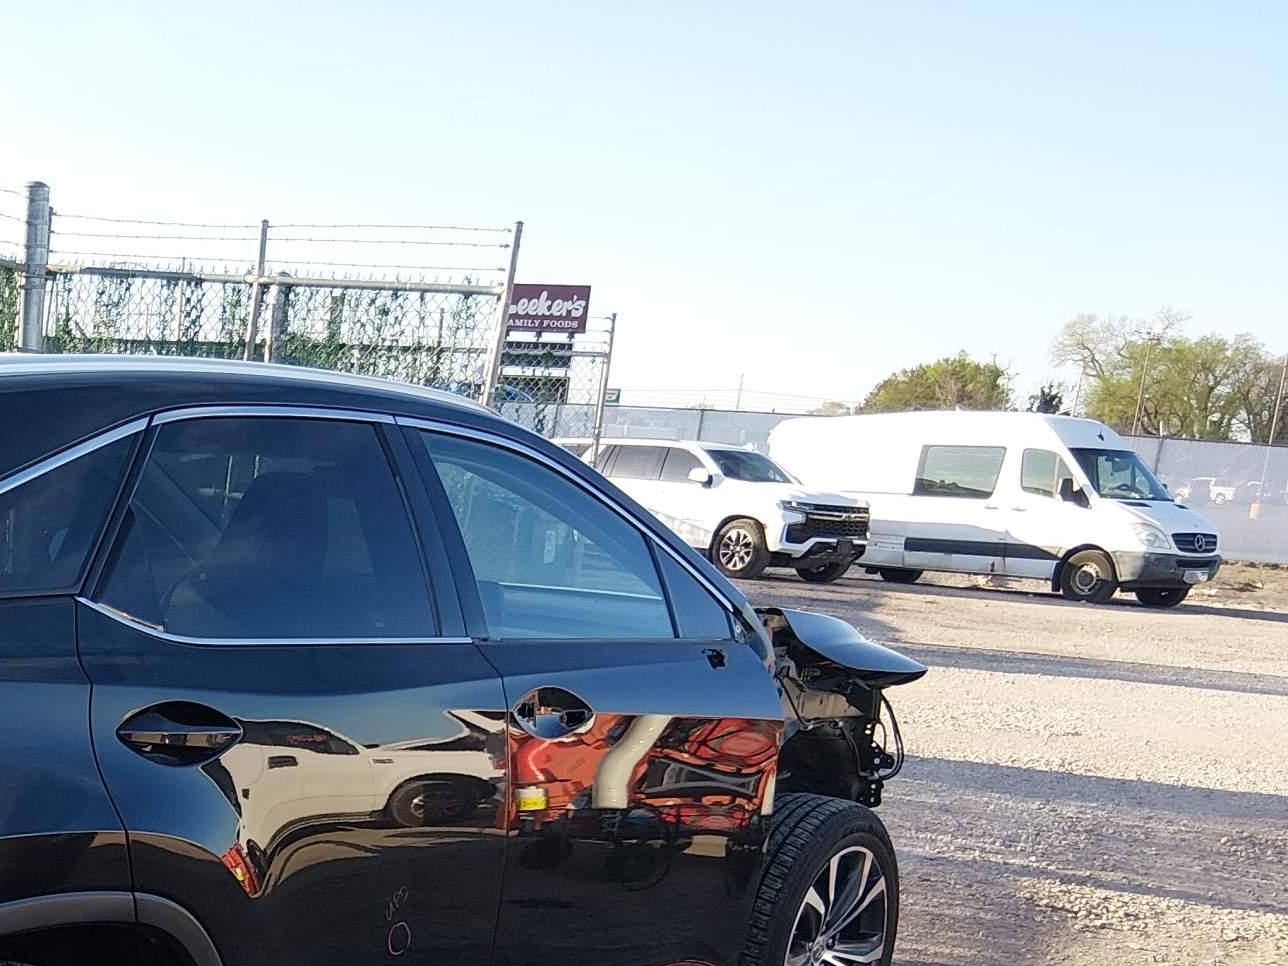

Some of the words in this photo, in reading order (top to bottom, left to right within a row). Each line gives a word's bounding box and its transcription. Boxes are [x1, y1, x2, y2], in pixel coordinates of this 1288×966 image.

[509, 291, 586, 317] eeker's
[506, 319, 540, 327] AMILY
[542, 319, 579, 329] FOODS
